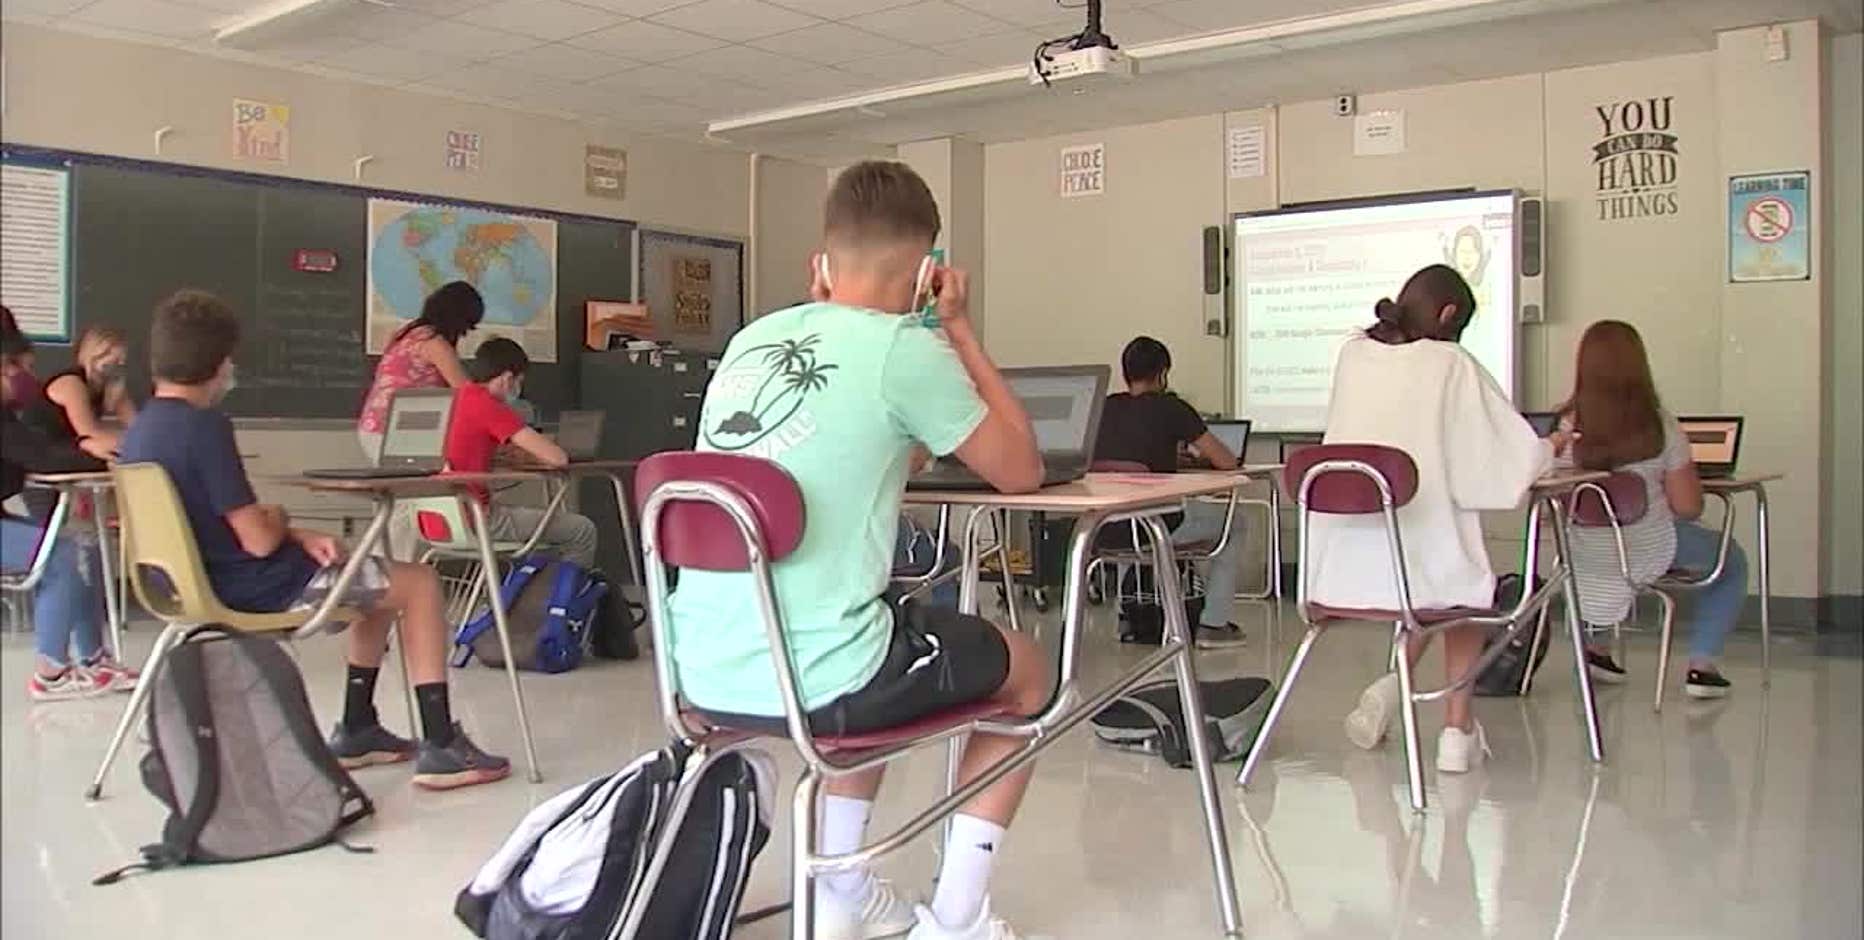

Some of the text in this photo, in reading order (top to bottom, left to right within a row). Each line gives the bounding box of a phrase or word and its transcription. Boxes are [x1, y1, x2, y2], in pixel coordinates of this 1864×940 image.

[1596, 96, 1674, 138] YOU
[1608, 134, 1663, 155] CAN DO
[1598, 152, 1677, 191] HARD
[1596, 191, 1679, 220] THINGS
